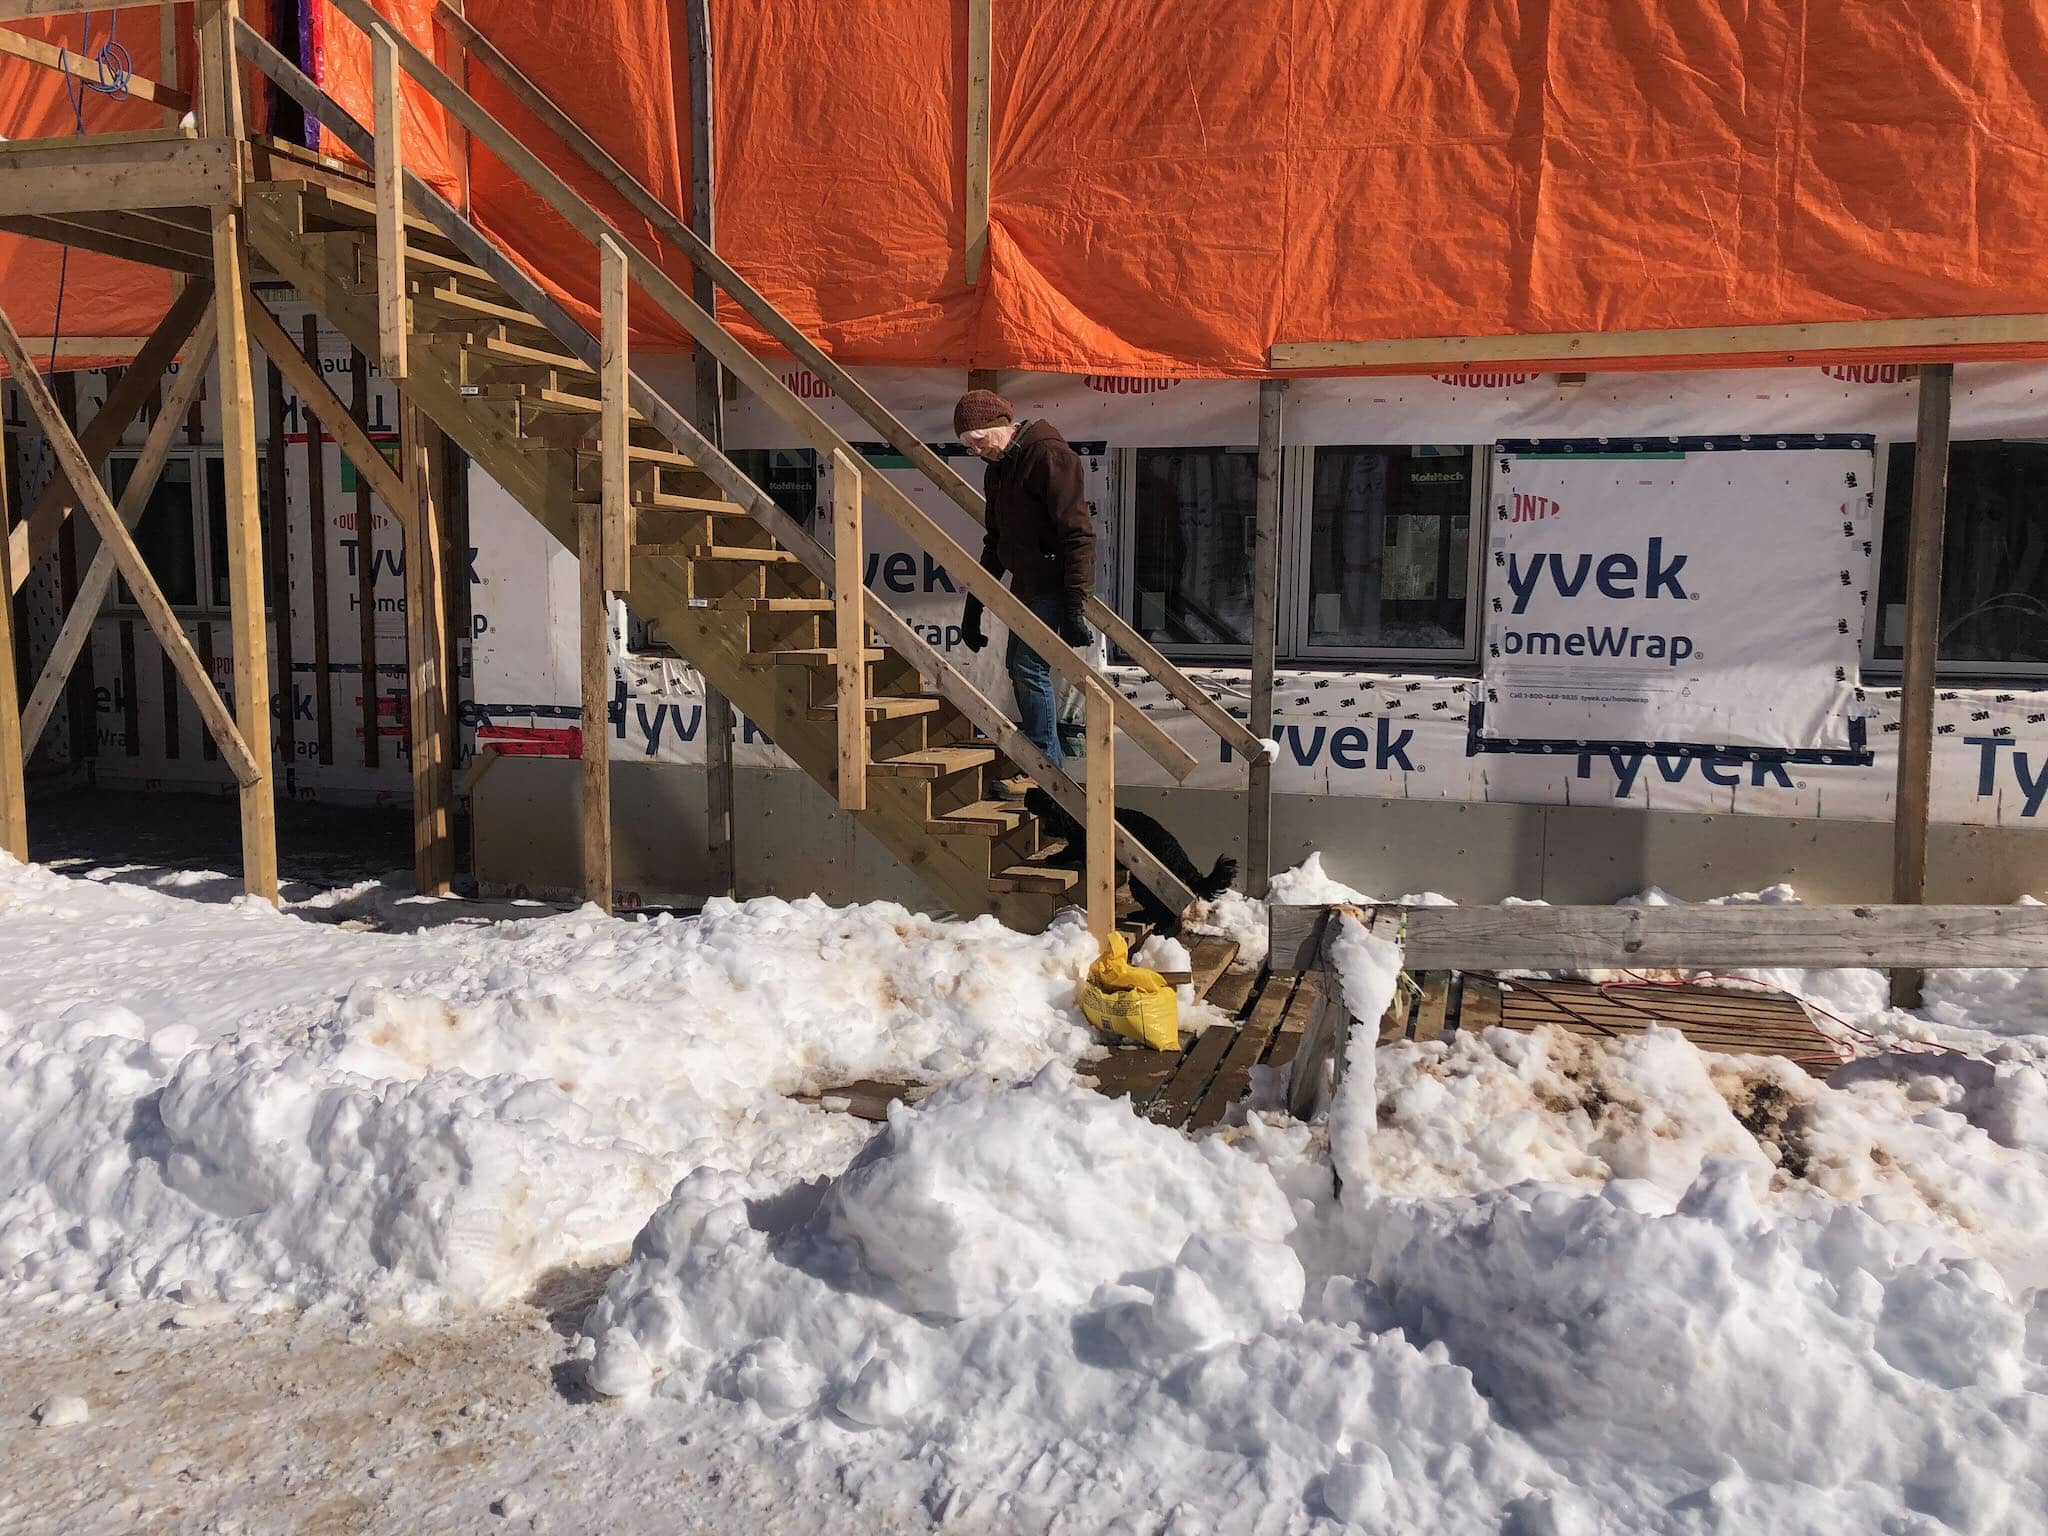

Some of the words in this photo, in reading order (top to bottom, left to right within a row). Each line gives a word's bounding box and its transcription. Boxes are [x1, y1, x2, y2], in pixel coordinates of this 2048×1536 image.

[317, 359, 381, 377] Hme
[1834, 364, 1903, 384] PONT
[1500, 458, 1511, 474] 3M
[1411, 472, 1464, 482] Kohltech
[1846, 471, 1857, 488] 3M
[1497, 504, 1508, 521] 3M
[340, 513, 382, 530] DUNT
[1843, 521, 1854, 537] 3M
[1494, 551, 1505, 567] 3M
[1507, 536, 1688, 615] yvek
[1840, 570, 1851, 586] 3M
[350, 593, 406, 612] Hme
[1493, 597, 1503, 613] 3M
[1837, 618, 1848, 634] 3M
[1489, 642, 1500, 658] 3M
[1505, 626, 1693, 666] omeWrap
[1835, 666, 1846, 682] 3M
[636, 678, 648, 687] 3M
[1314, 679, 1329, 690] 3M
[1359, 681, 1375, 691] 3M
[1405, 682, 1421, 692] 3M
[1295, 696, 1310, 706] 3M
[1340, 698, 1356, 708] 3M
[1487, 687, 1498, 703] 3M
[1940, 691, 1959, 701] 3M
[1995, 693, 2015, 703] 3M
[1385, 699, 1401, 710] 3M
[1432, 701, 1448, 711] 3M
[615, 692, 774, 756] Tyv
[1971, 711, 1989, 722] 3M
[2026, 713, 2046, 724] 3M
[1937, 724, 1956, 735] 3M
[1992, 726, 2012, 736] 3M
[1220, 712, 1415, 771] vek
